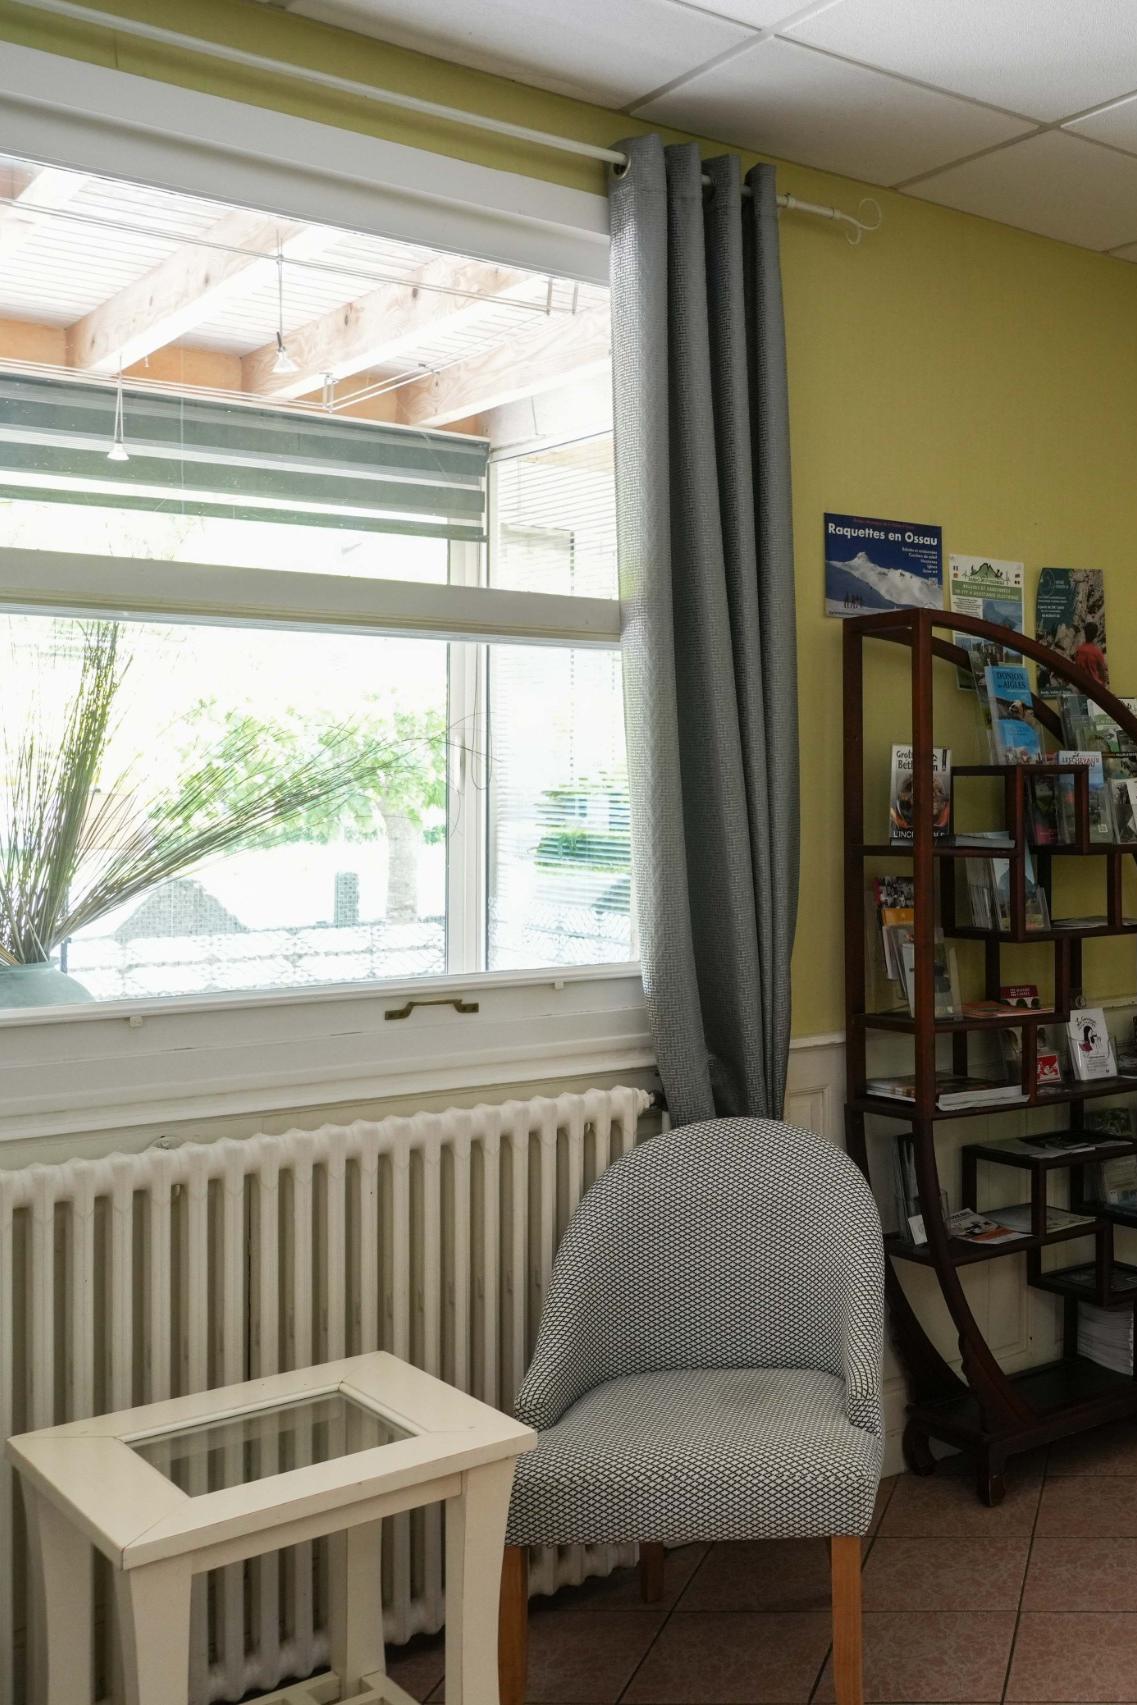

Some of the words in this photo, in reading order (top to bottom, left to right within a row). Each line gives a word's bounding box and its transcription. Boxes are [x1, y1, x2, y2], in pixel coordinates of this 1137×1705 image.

[828, 523, 887, 539] Raquettes
[888, 532, 902, 542] en
[905, 532, 938, 546] Ossau
